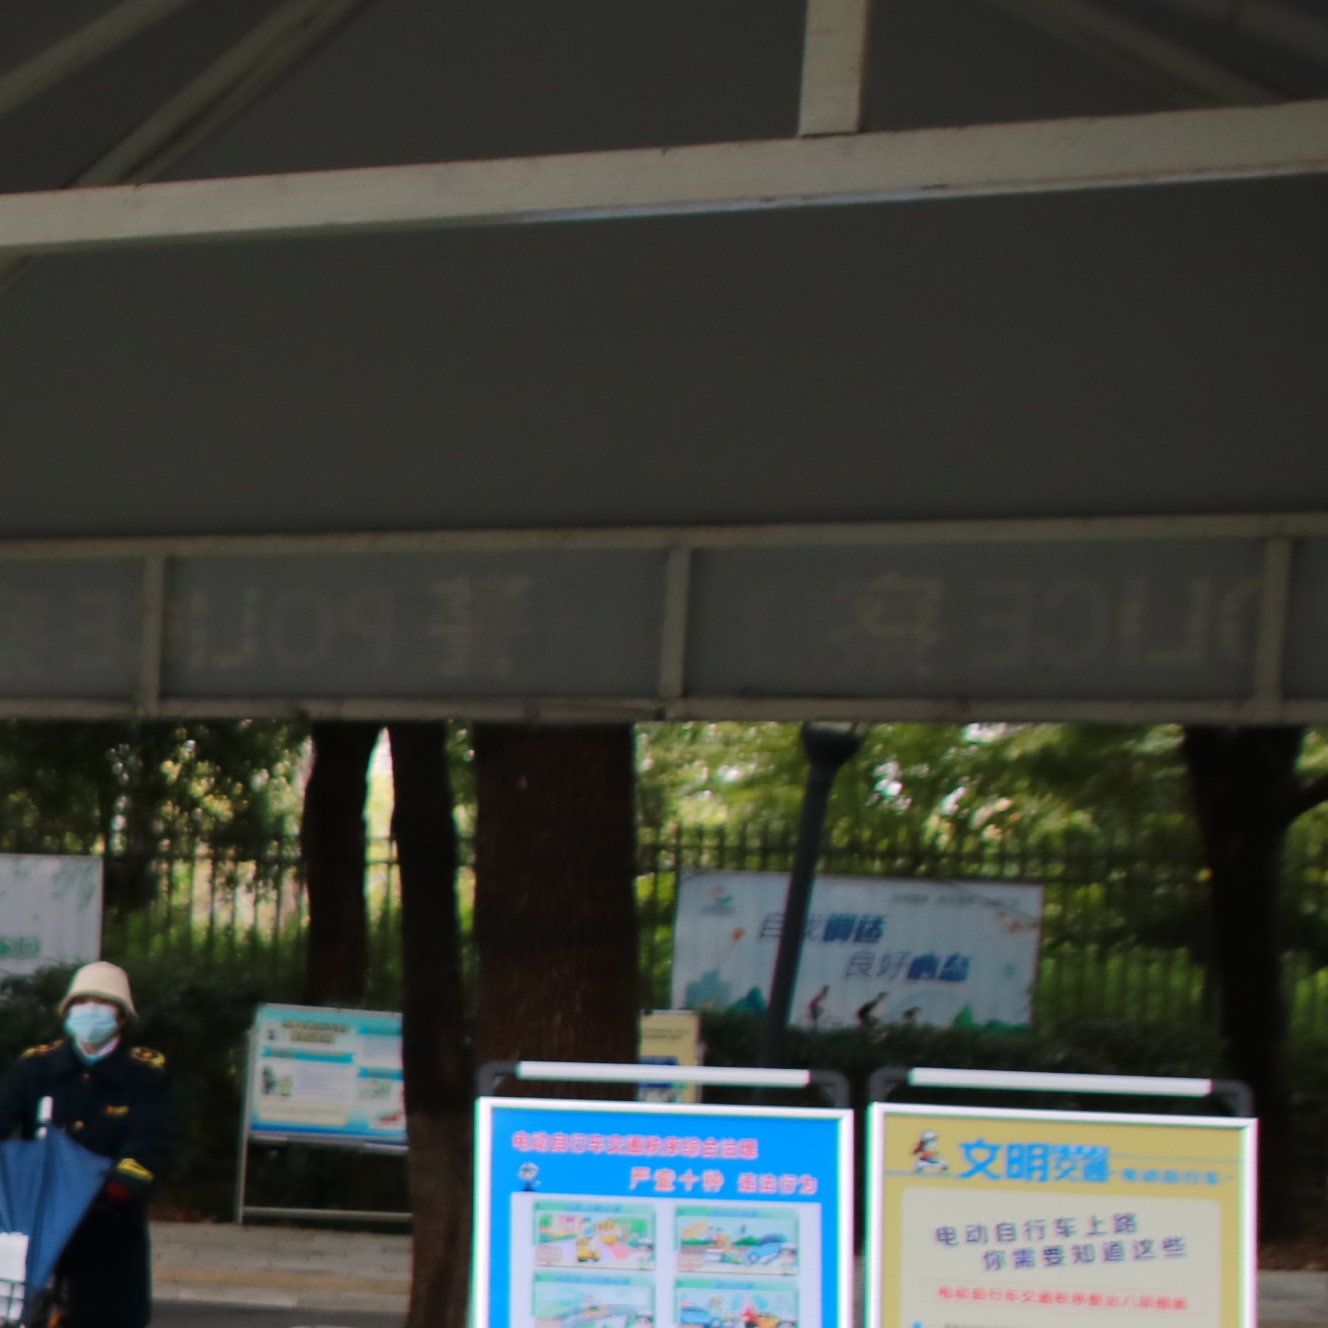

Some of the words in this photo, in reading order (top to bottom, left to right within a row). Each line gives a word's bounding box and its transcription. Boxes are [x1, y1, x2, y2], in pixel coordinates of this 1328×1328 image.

[934, 1212, 1138, 1248] 电动自行车上路
[982, 1234, 1188, 1272] 你需要知道这些
